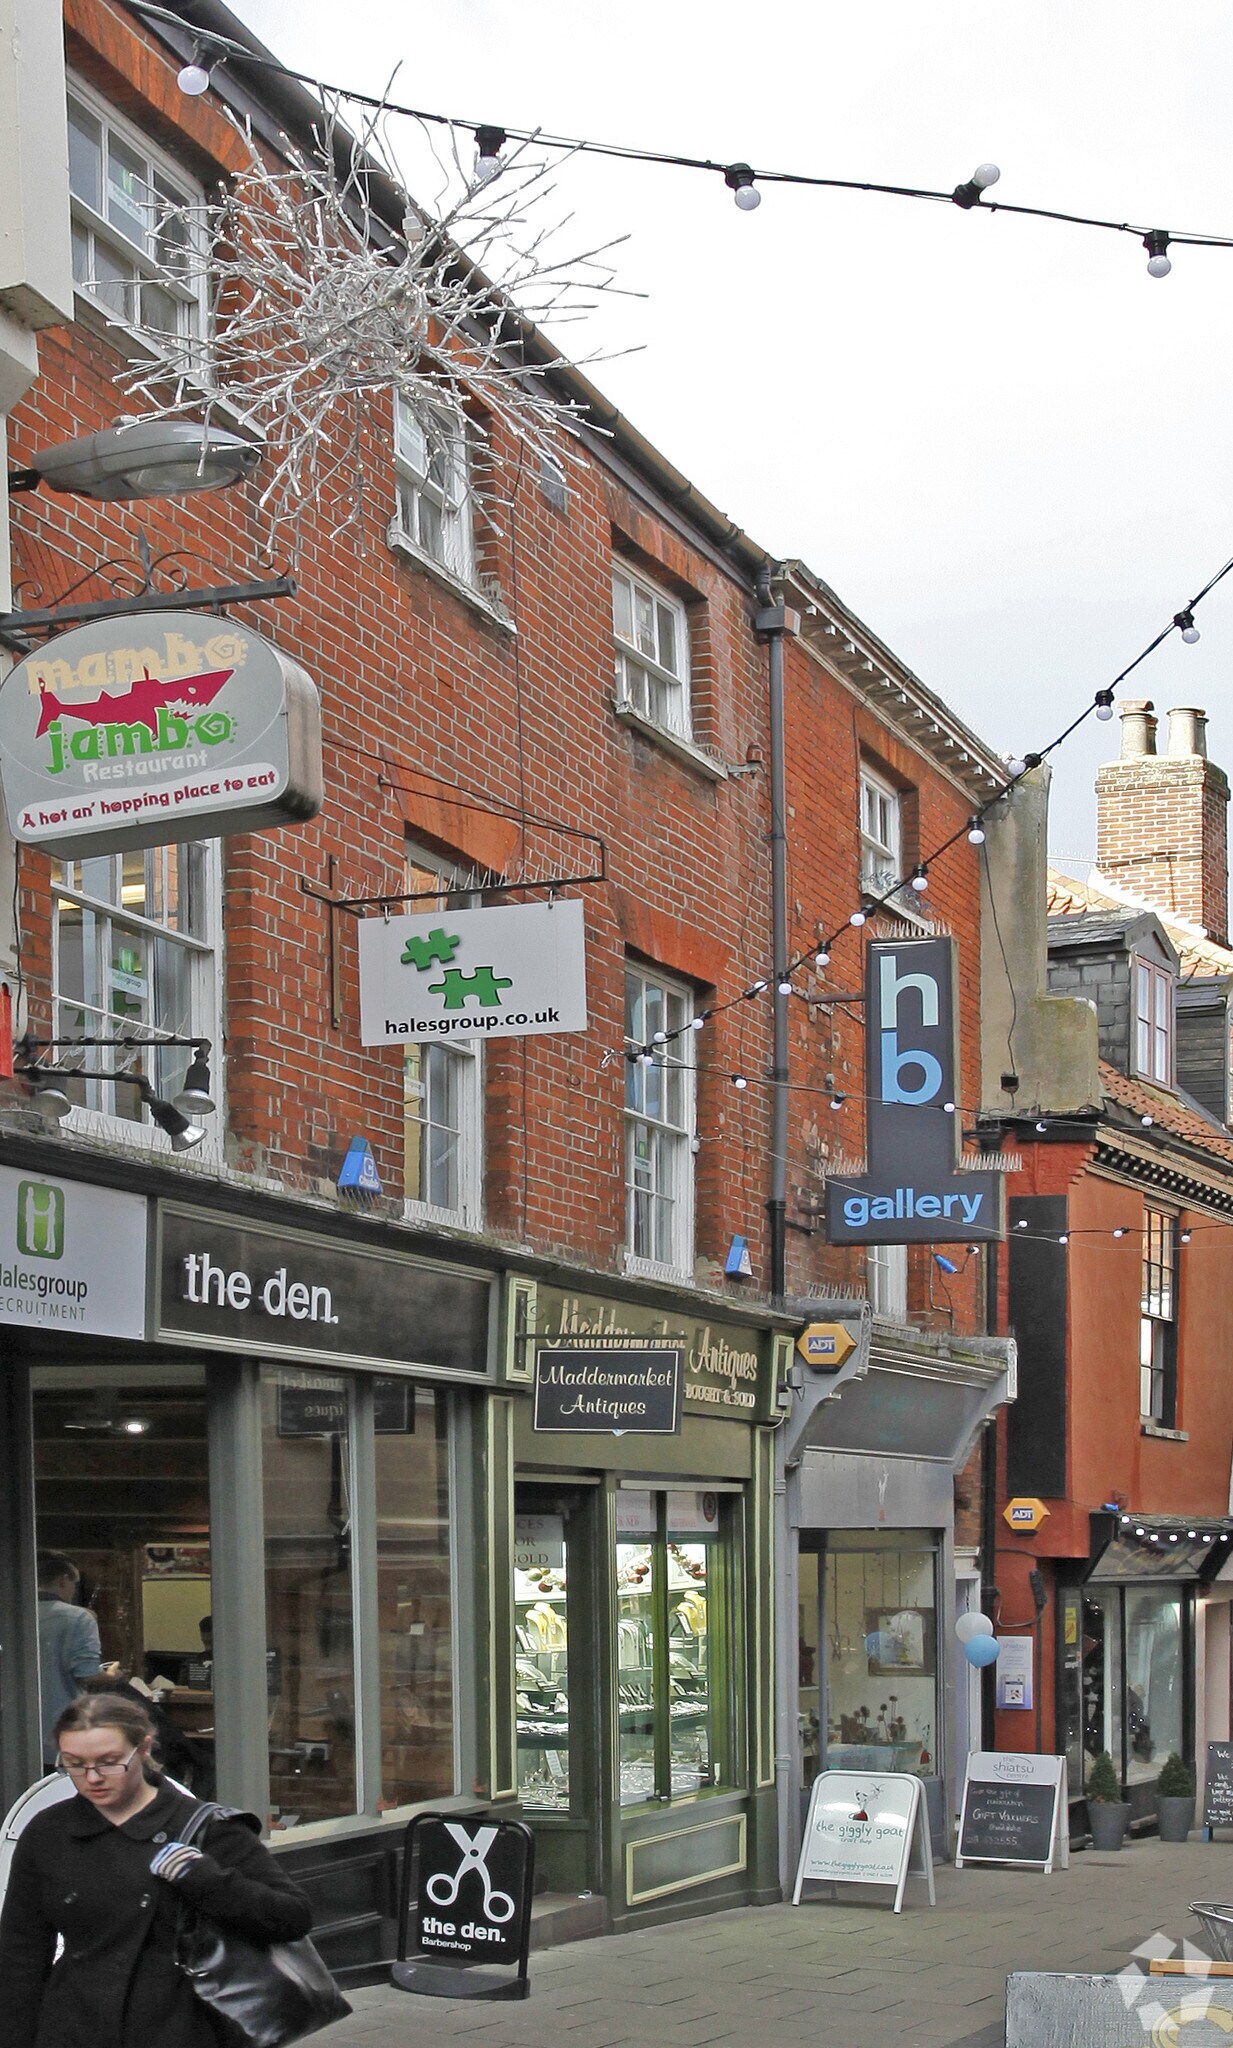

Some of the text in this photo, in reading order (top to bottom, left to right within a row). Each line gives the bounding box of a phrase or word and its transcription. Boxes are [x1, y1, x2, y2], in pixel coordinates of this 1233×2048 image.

[26, 633, 248, 695] mambo
[46, 707, 239, 775] jambo
[83, 750, 207, 783] Restaurant
[22, 813, 36, 829] A
[40, 808, 67, 825] hot
[100, 792, 170, 816] hopping
[174, 783, 219, 804] place
[224, 778, 243, 792] to
[247, 770, 276, 788] eat
[385, 1007, 560, 1035] halesgroup.co.uk
[844, 1188, 983, 1227] gallery
[185, 1253, 338, 1324] the den.
[808, 1338, 835, 1351] ADT
[690, 1327, 757, 1390] Antiques
[540, 1366, 672, 1387] Maddermarket
[560, 1394, 646, 1419] Antiques
[685, 1383, 721, 1403] BOUGHT
[733, 1391, 756, 1408] SOLD
[1012, 1510, 1034, 1520] ADT
[993, 1762, 1034, 1773] shiatsu
[816, 1820, 905, 1840] the giggly goat
[422, 1917, 506, 1943] the den.
[422, 1936, 472, 1952] Barbershop
